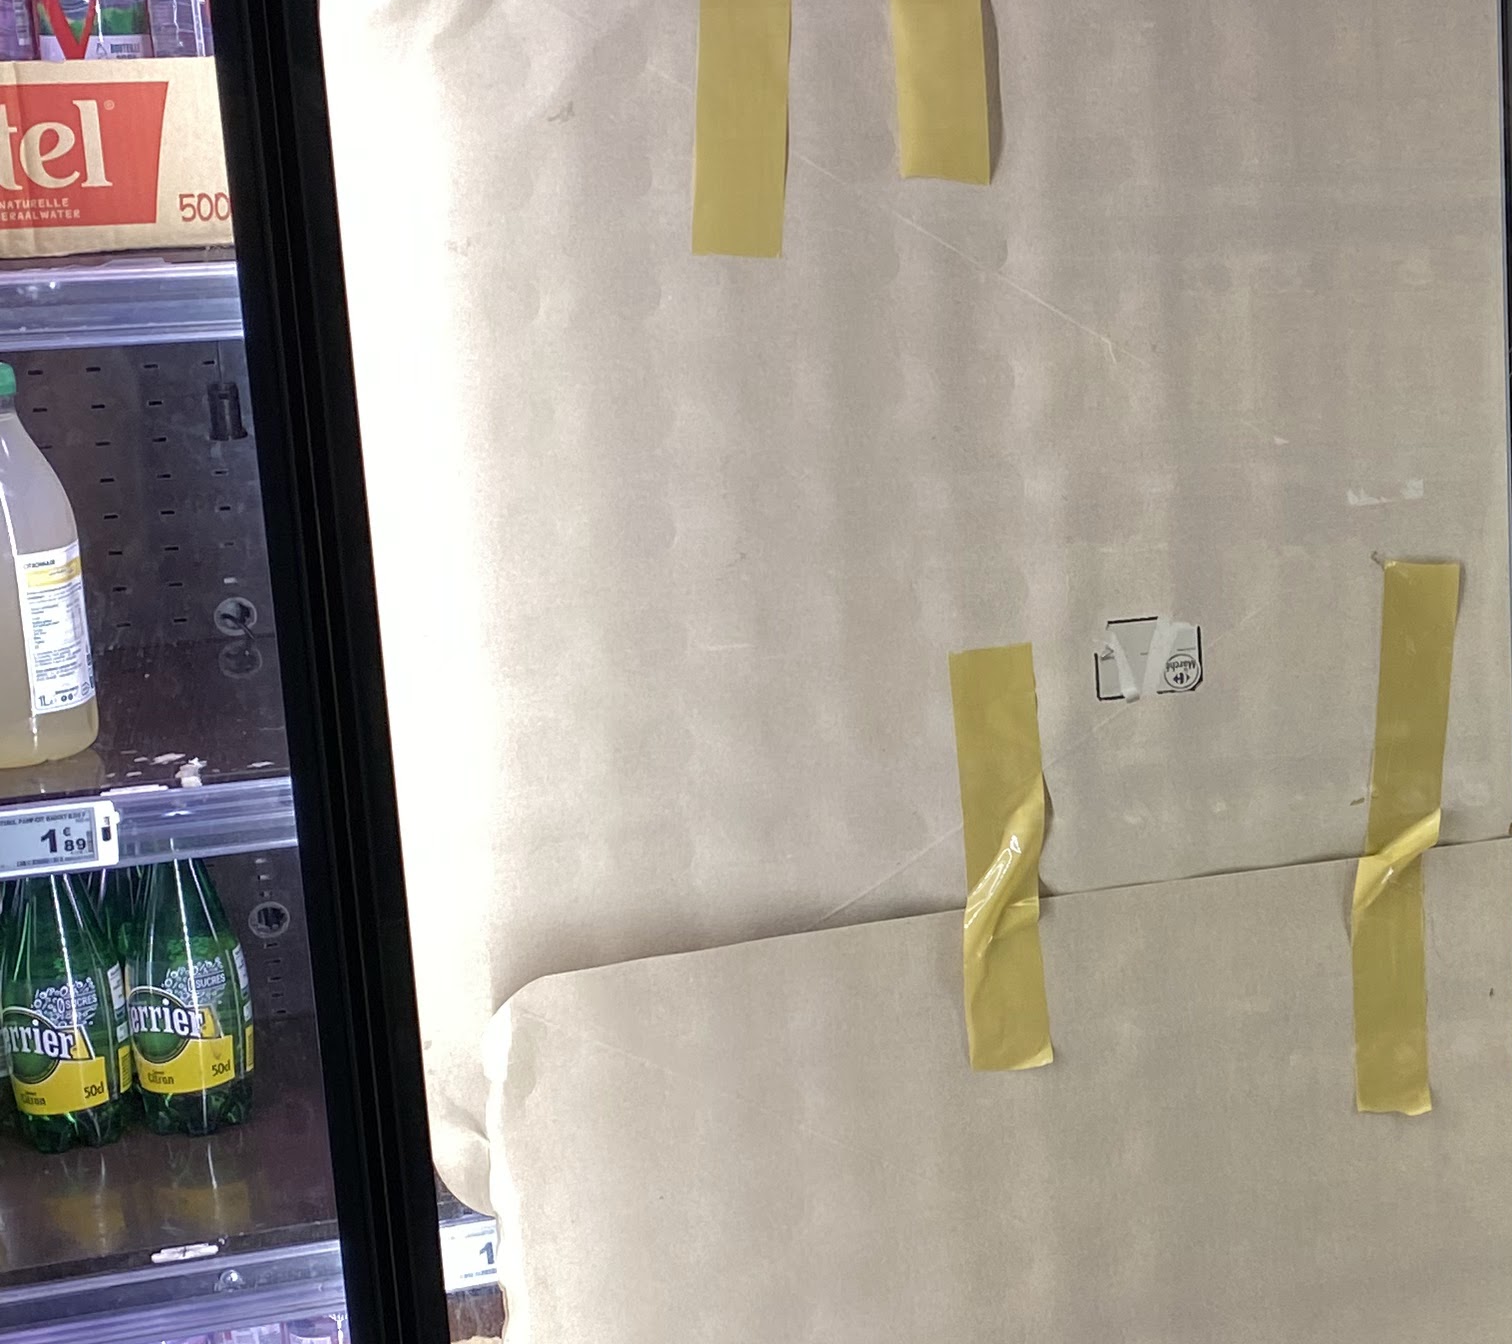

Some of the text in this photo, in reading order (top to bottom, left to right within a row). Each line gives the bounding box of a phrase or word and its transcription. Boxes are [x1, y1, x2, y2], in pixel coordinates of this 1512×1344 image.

[0, 209, 81, 221] ERAALWATER
[130, 998, 204, 1039] errier
[3, 1018, 76, 1060] errier
[211, 1064, 232, 1078] 50cl
